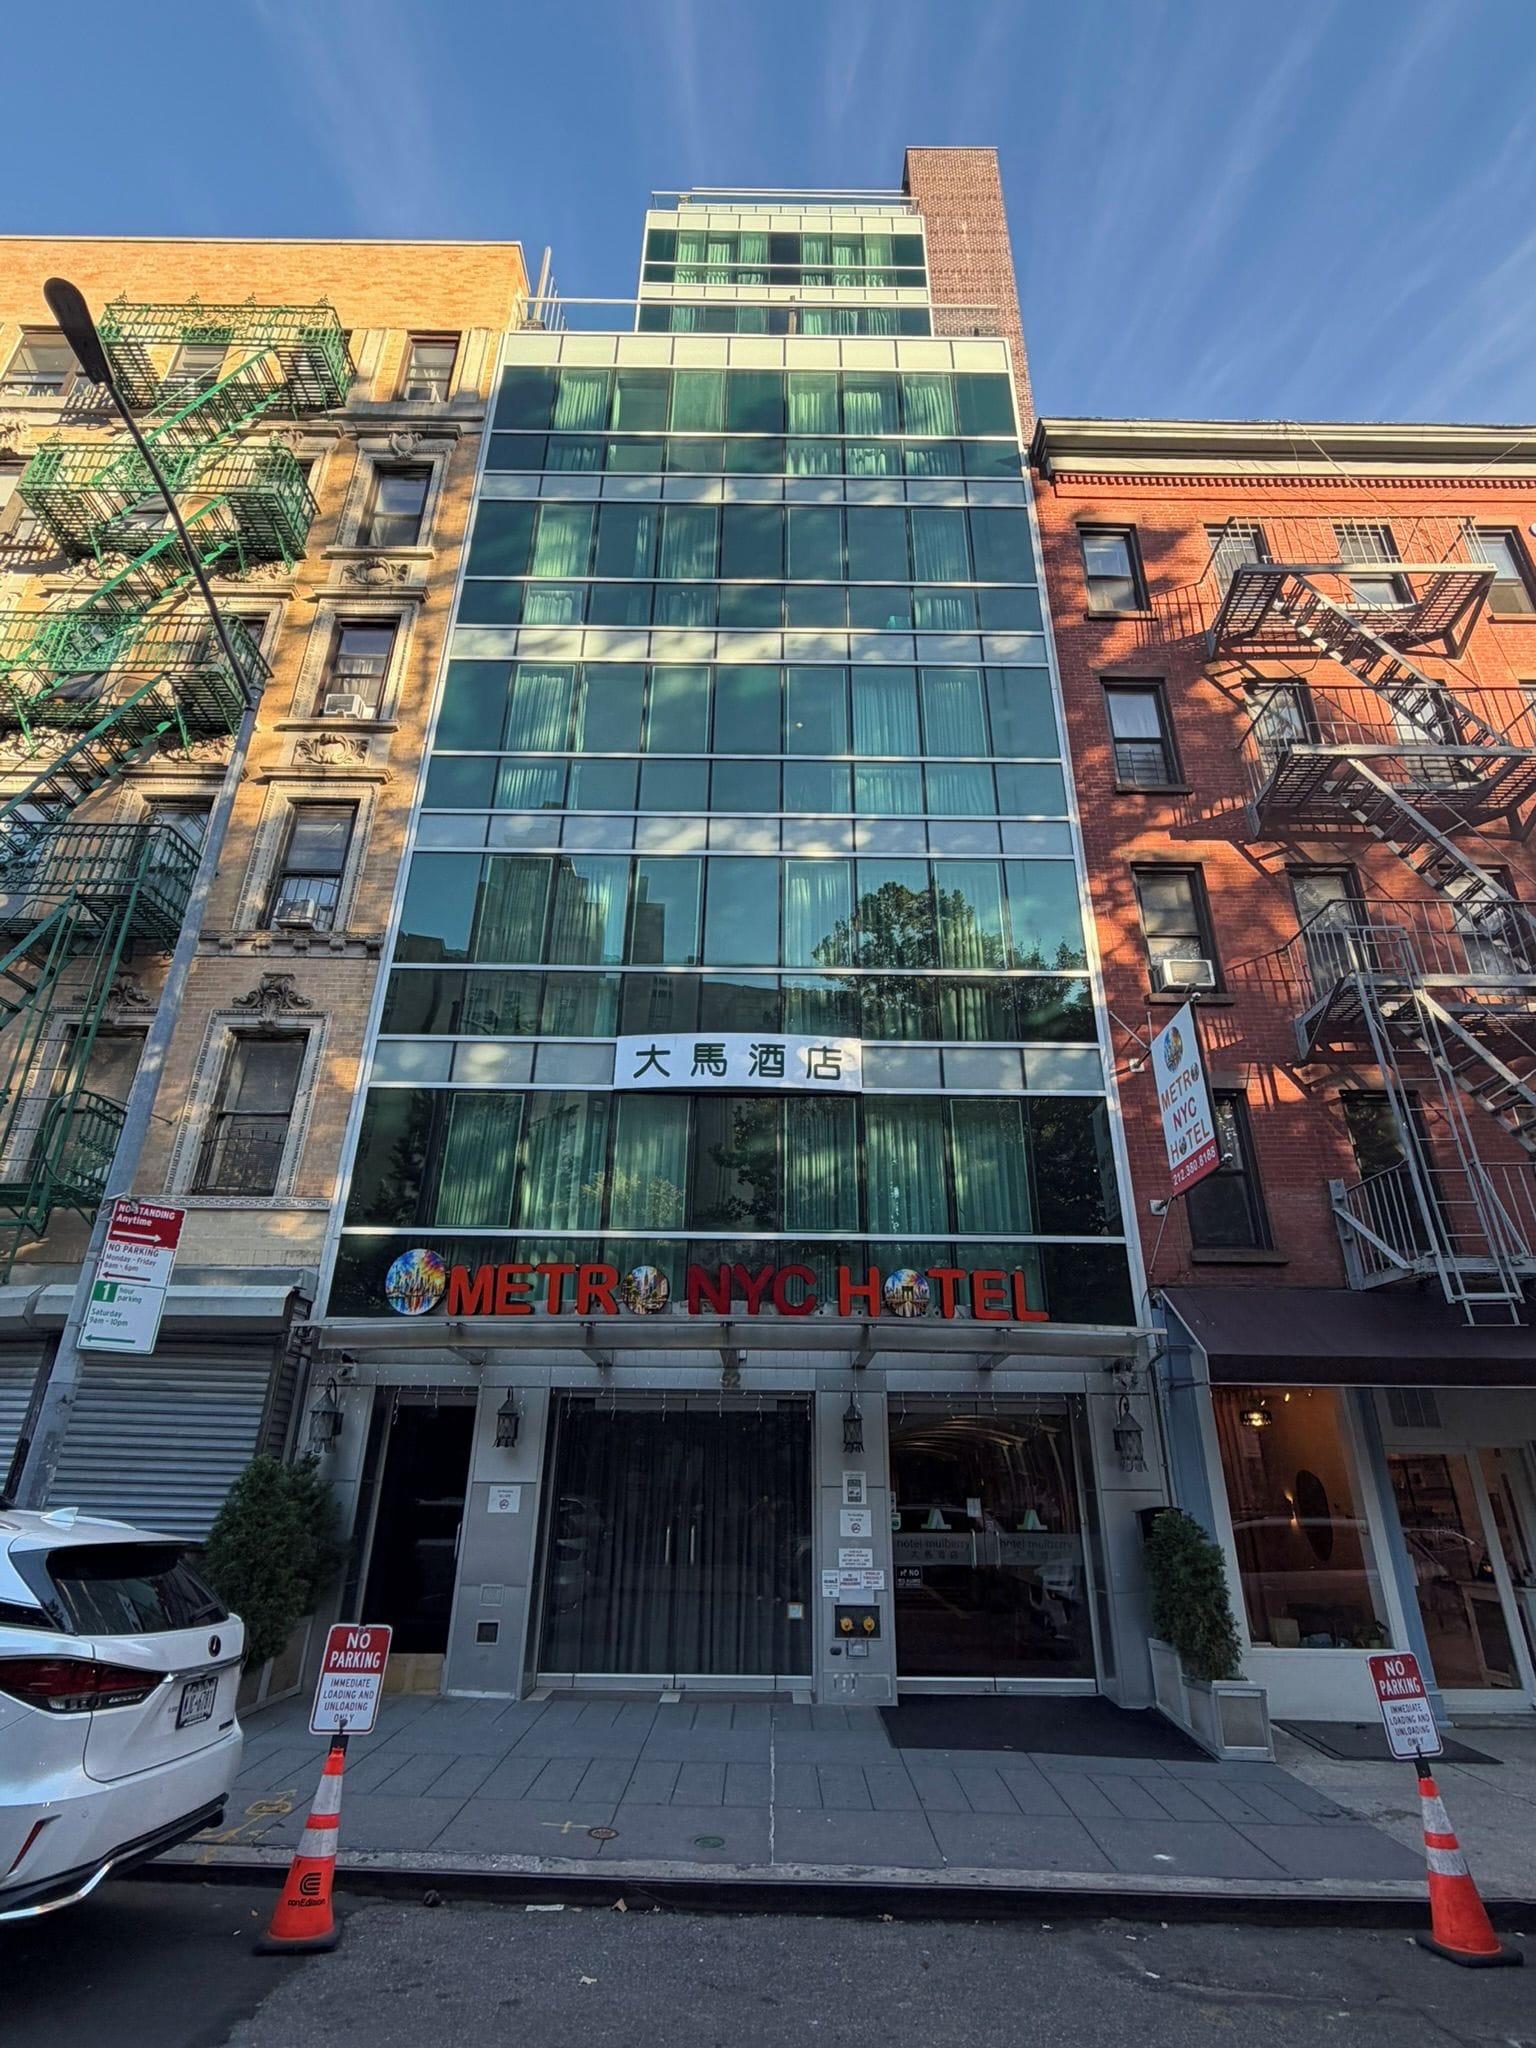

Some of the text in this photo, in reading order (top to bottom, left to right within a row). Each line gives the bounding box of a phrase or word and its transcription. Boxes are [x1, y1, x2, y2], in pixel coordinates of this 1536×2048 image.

[633, 1043, 842, 1080] 大馬酒店
[1173, 1096, 1197, 1132] NYC
[118, 1204, 176, 1220] NO STANDING
[116, 1213, 153, 1227] Anytime
[108, 1243, 159, 1258] NO PARKING
[106, 1253, 131, 1263] Monday
[103, 1283, 135, 1300] 1 hour
[687, 1263, 817, 1316] NYC
[117, 1294, 142, 1304] parking
[91, 1308, 123, 1318] Saturday
[89, 1316, 104, 1325] 9am
[346, 1632, 371, 1649] NO
[329, 1651, 381, 1669] PARKING
[1384, 1660, 1405, 1677] NO
[330, 1678, 371, 1688] IMMEDIATE
[1379, 1677, 1421, 1696] PARKING
[323, 1690, 375, 1700] LOADING AND
[324, 1701, 368, 1712] UNLOADING
[1390, 1703, 1423, 1714] IMMEDIATE
[1389, 1713, 1430, 1726] LOADING AND
[1394, 1725, 1431, 1737] UNLOADING
